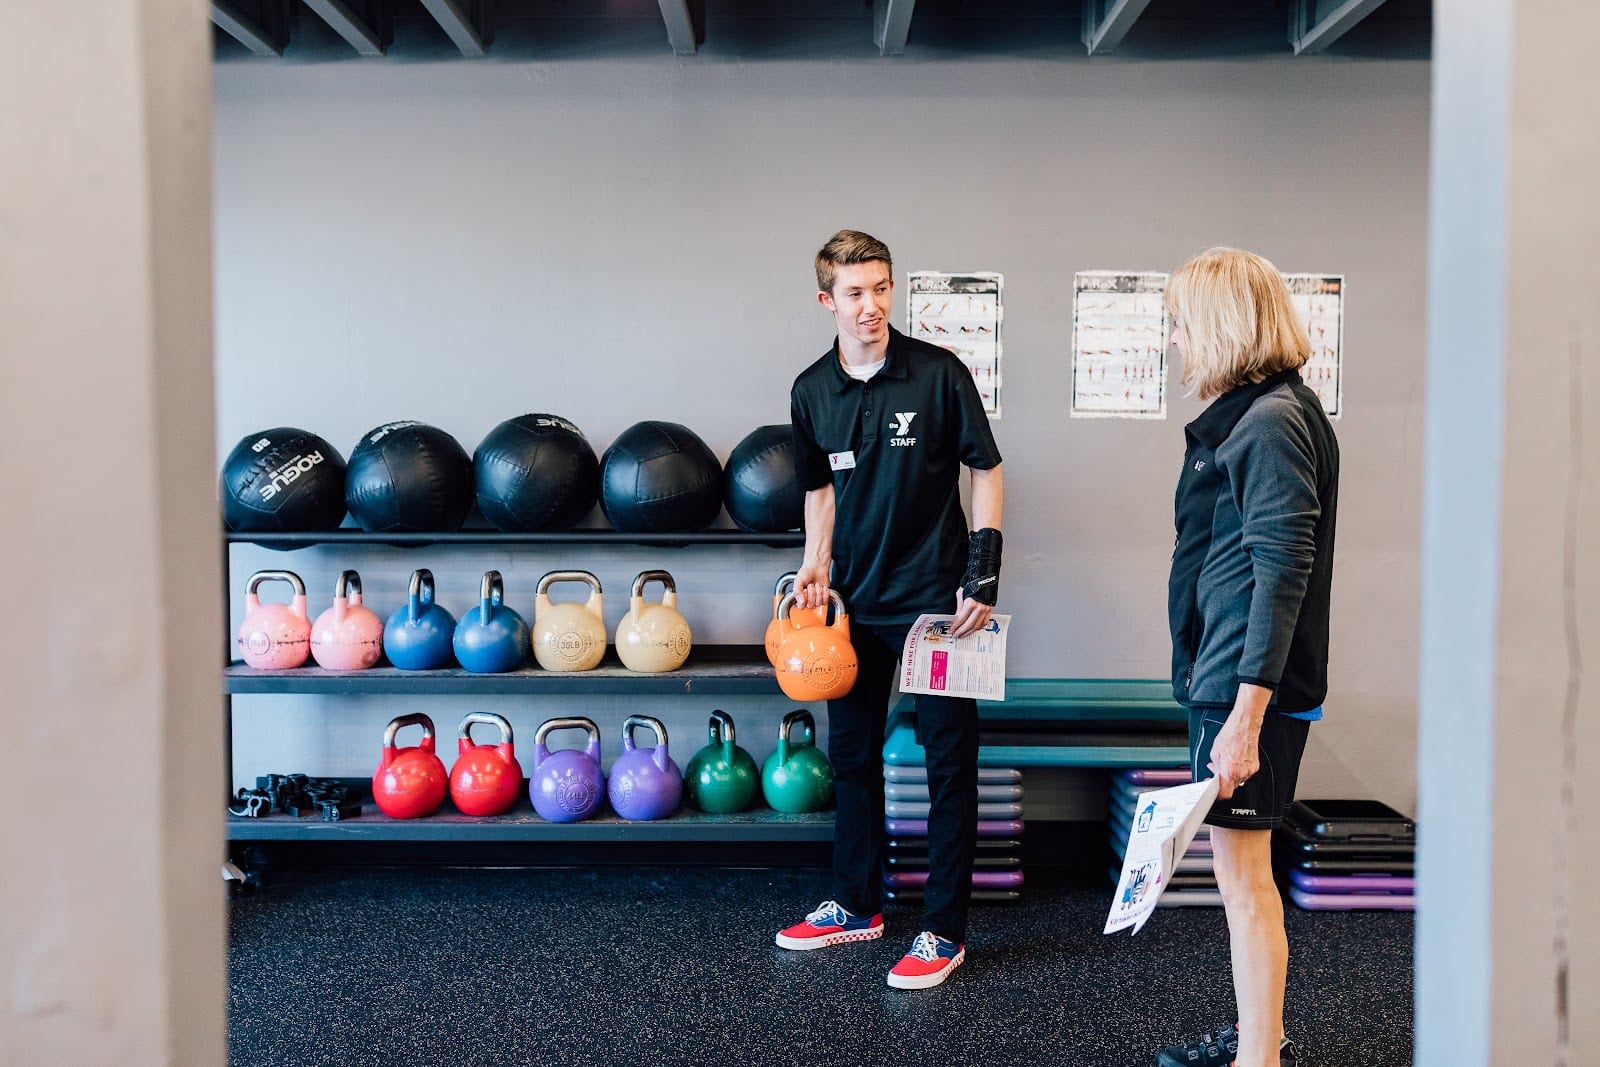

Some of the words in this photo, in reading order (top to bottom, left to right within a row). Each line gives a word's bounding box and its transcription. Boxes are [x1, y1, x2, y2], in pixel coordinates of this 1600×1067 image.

[890, 437, 917, 447] STAFF
[259, 450, 325, 501] ROGUE
[560, 640, 580, 649] 35LB
